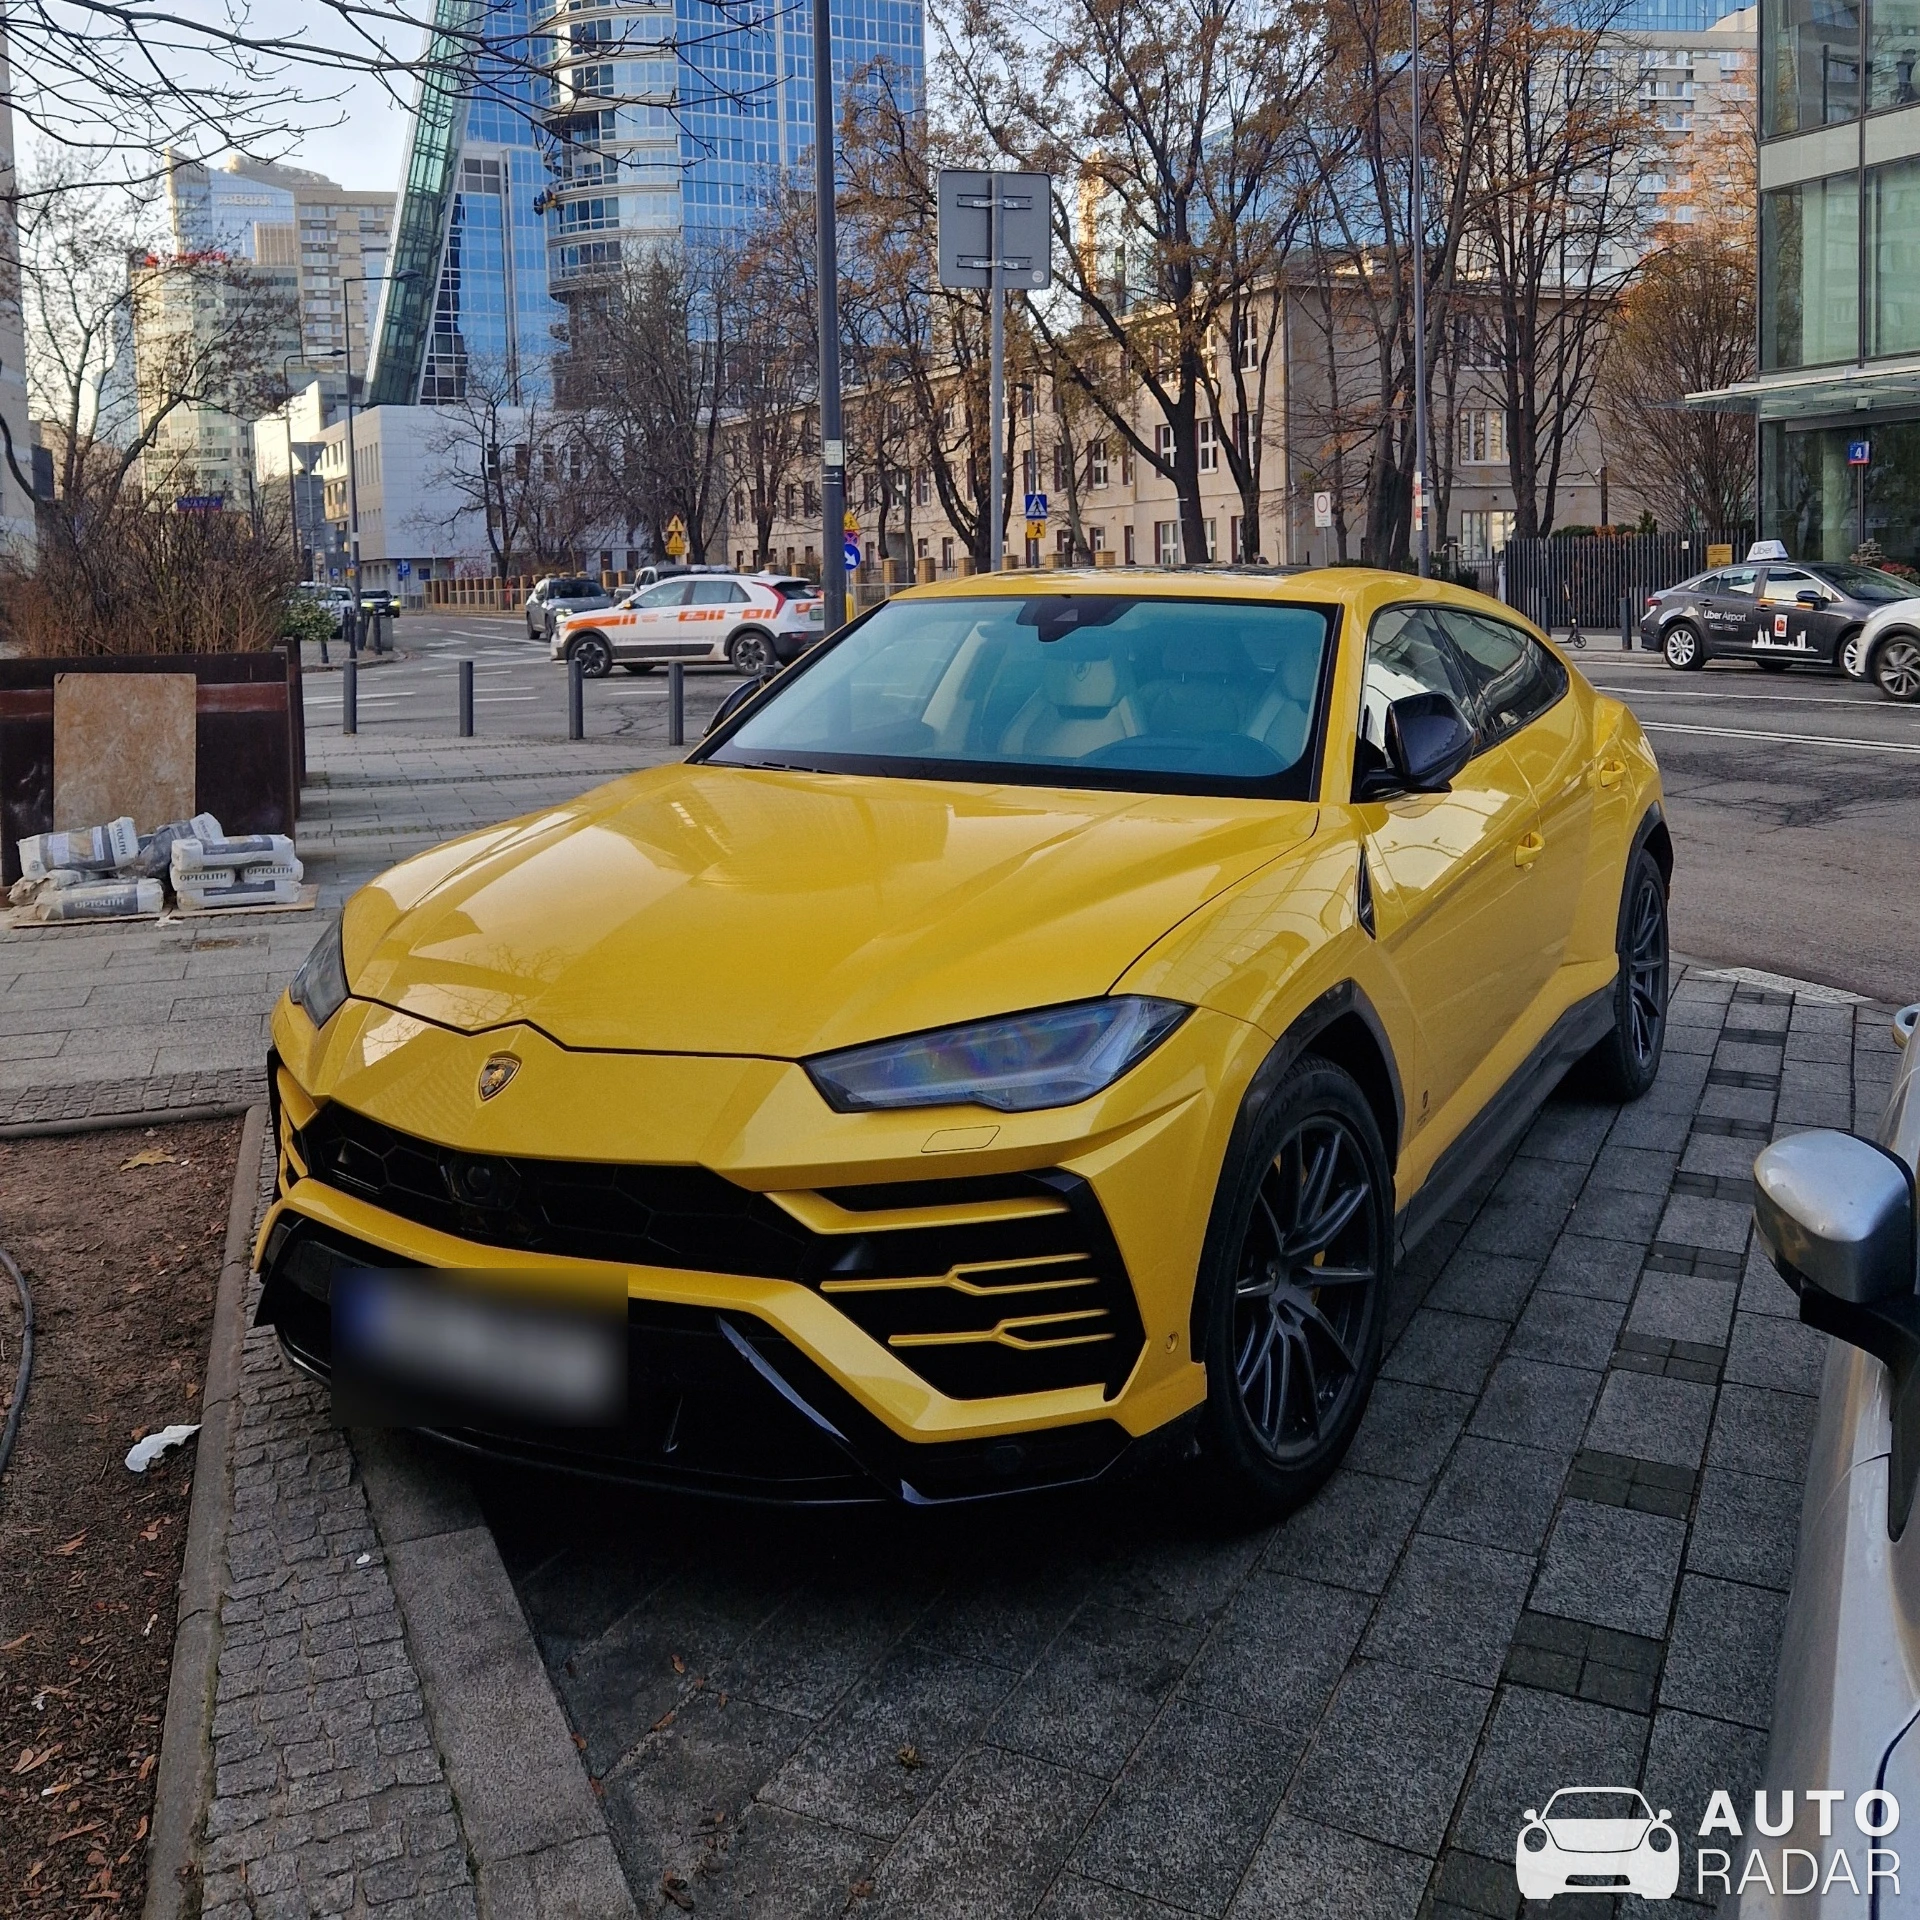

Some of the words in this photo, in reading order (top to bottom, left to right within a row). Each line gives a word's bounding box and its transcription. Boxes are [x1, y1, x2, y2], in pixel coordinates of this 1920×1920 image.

[1855, 447, 1862, 459] 4
[1753, 546, 1773, 555] Uber
[1703, 610, 1722, 620] Uber
[1722, 611, 1747, 622] Airport
[247, 867, 293, 875] OPTOLITH
[179, 872, 227, 882] OPTOLITH
[74, 898, 125, 909] OPTOLITH
